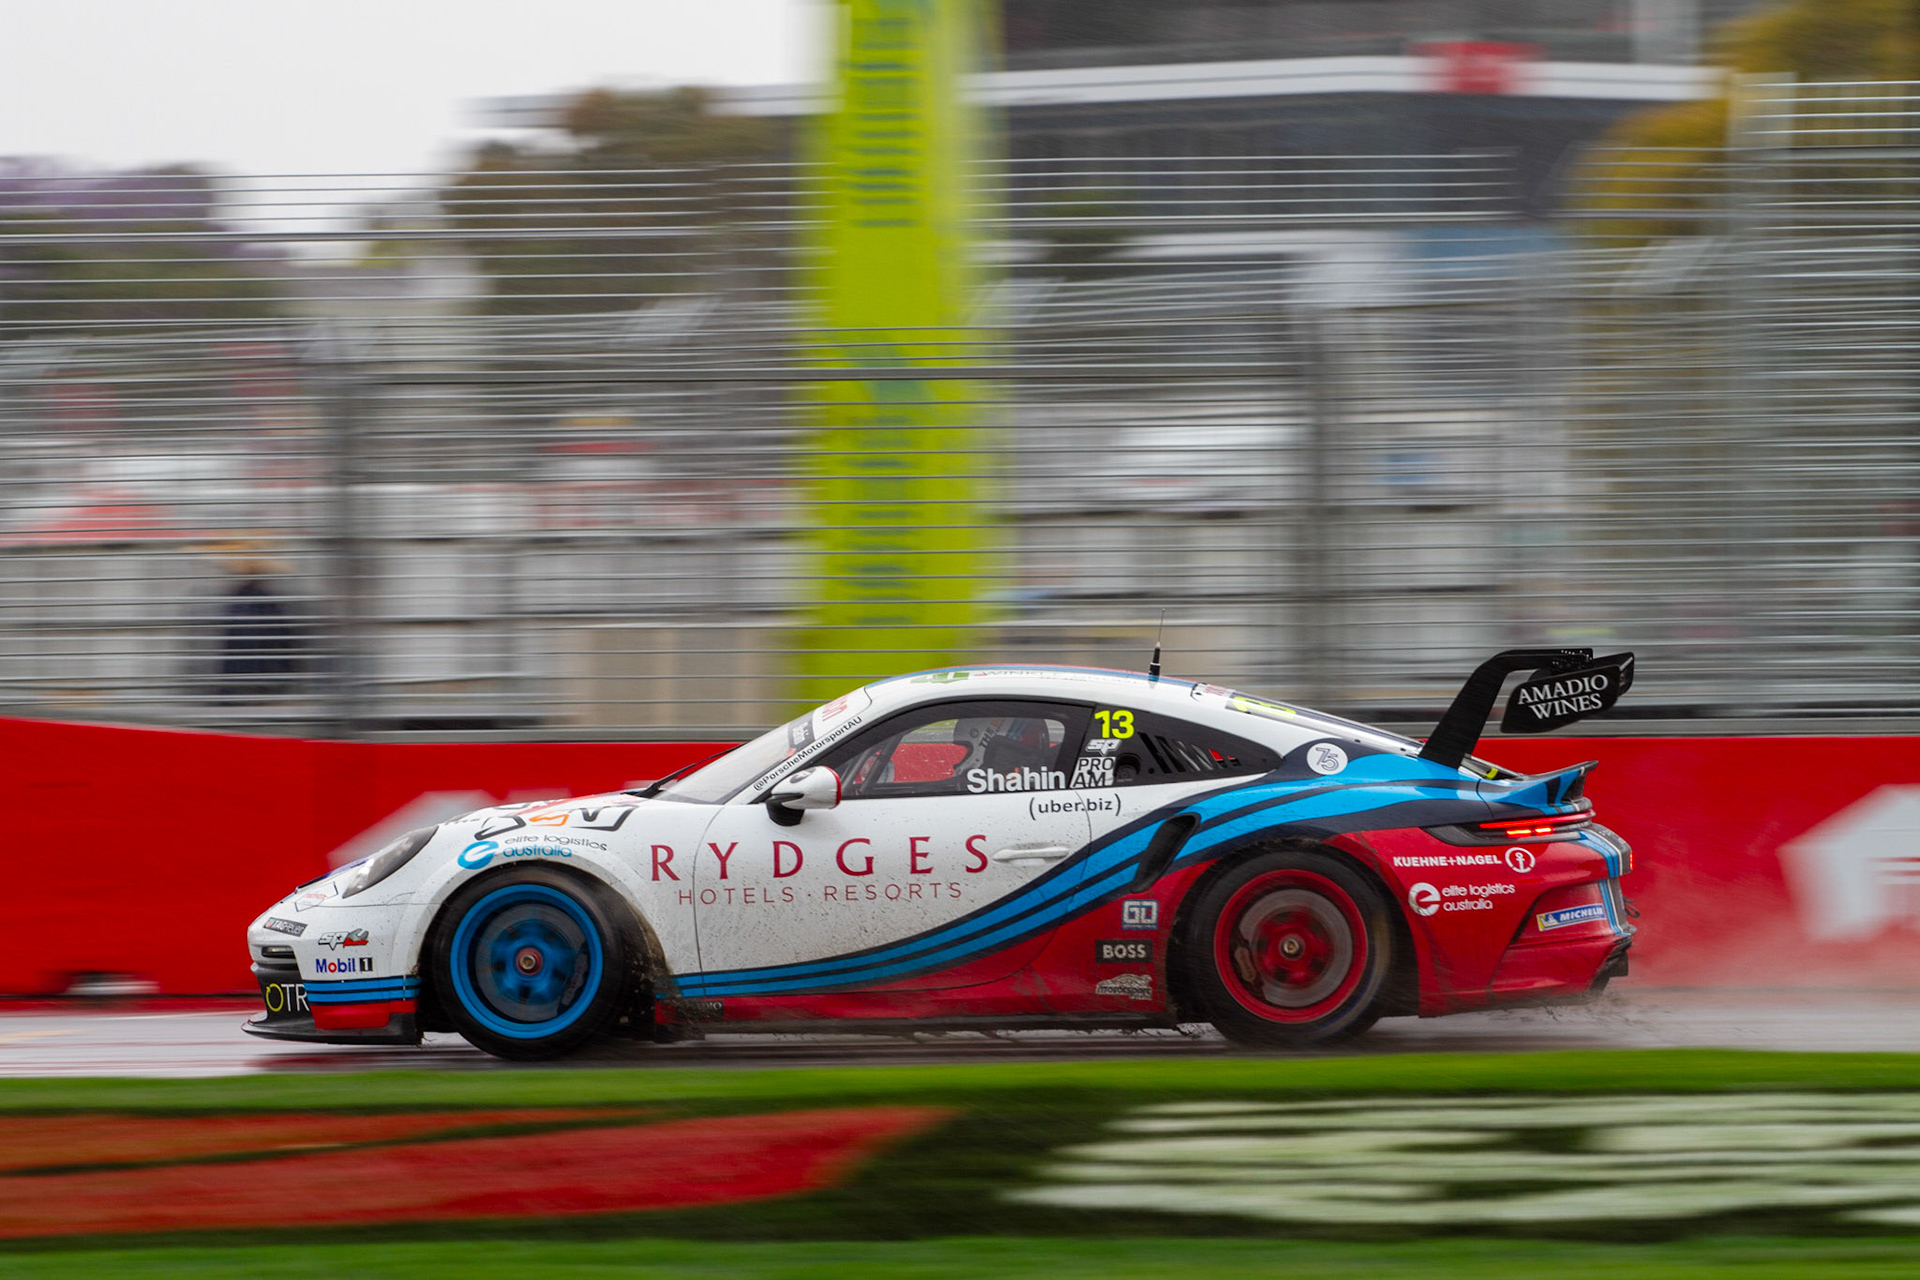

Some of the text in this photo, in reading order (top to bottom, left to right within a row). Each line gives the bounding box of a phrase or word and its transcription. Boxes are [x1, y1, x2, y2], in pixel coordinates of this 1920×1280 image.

[1517, 674, 1609, 705] AMADIO
[1528, 693, 1603, 720] WINES
[1094, 710, 1134, 739] 13
[753, 715, 863, 792] @PorscheMotorsportAU
[1315, 747, 1339, 771] 75
[1078, 757, 1115, 771] PRO
[966, 766, 1066, 793] Shahin
[1073, 771, 1106, 788] AM
[1029, 793, 1121, 821] (uber.biz)
[502, 843, 572, 858] australia
[504, 834, 608, 851] elite logistics
[651, 834, 988, 881] RYDGES
[1393, 855, 1502, 867] KUEHNE+NAGEL
[678, 882, 962, 905] HOTELS RESORTS
[1441, 883, 1515, 898] elite logistics
[1442, 899, 1493, 912] australia
[1560, 907, 1603, 922] MICHELIN
[1102, 944, 1147, 959] BOSS
[315, 957, 356, 973] Mobil
[265, 983, 310, 1012] OTR
